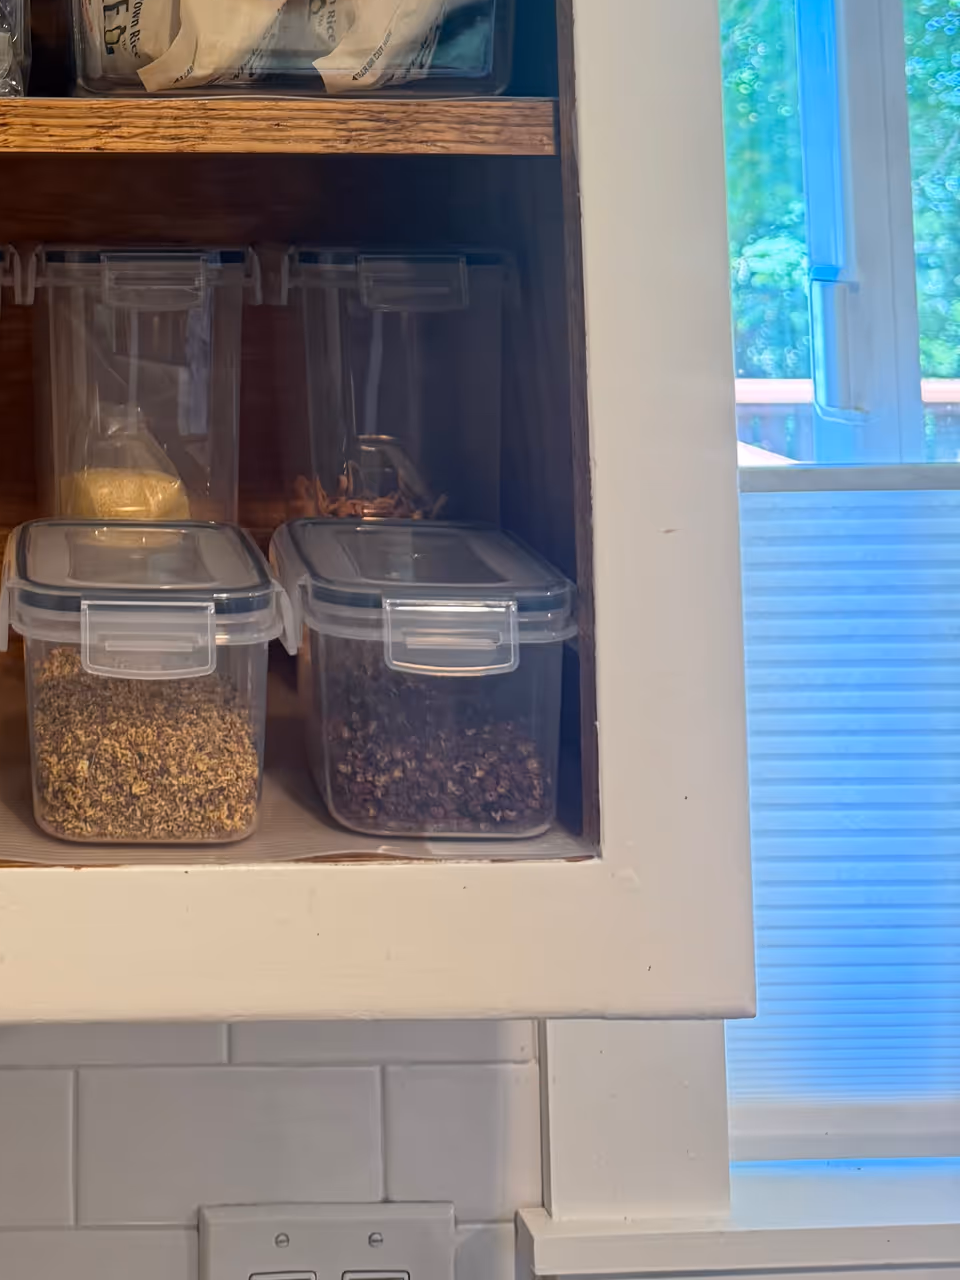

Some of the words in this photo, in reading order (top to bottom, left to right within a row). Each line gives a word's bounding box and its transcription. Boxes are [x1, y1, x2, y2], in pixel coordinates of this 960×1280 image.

[326, 10, 337, 43] Rice
[128, 29, 142, 60] Rice
[373, 45, 385, 60] CUT
